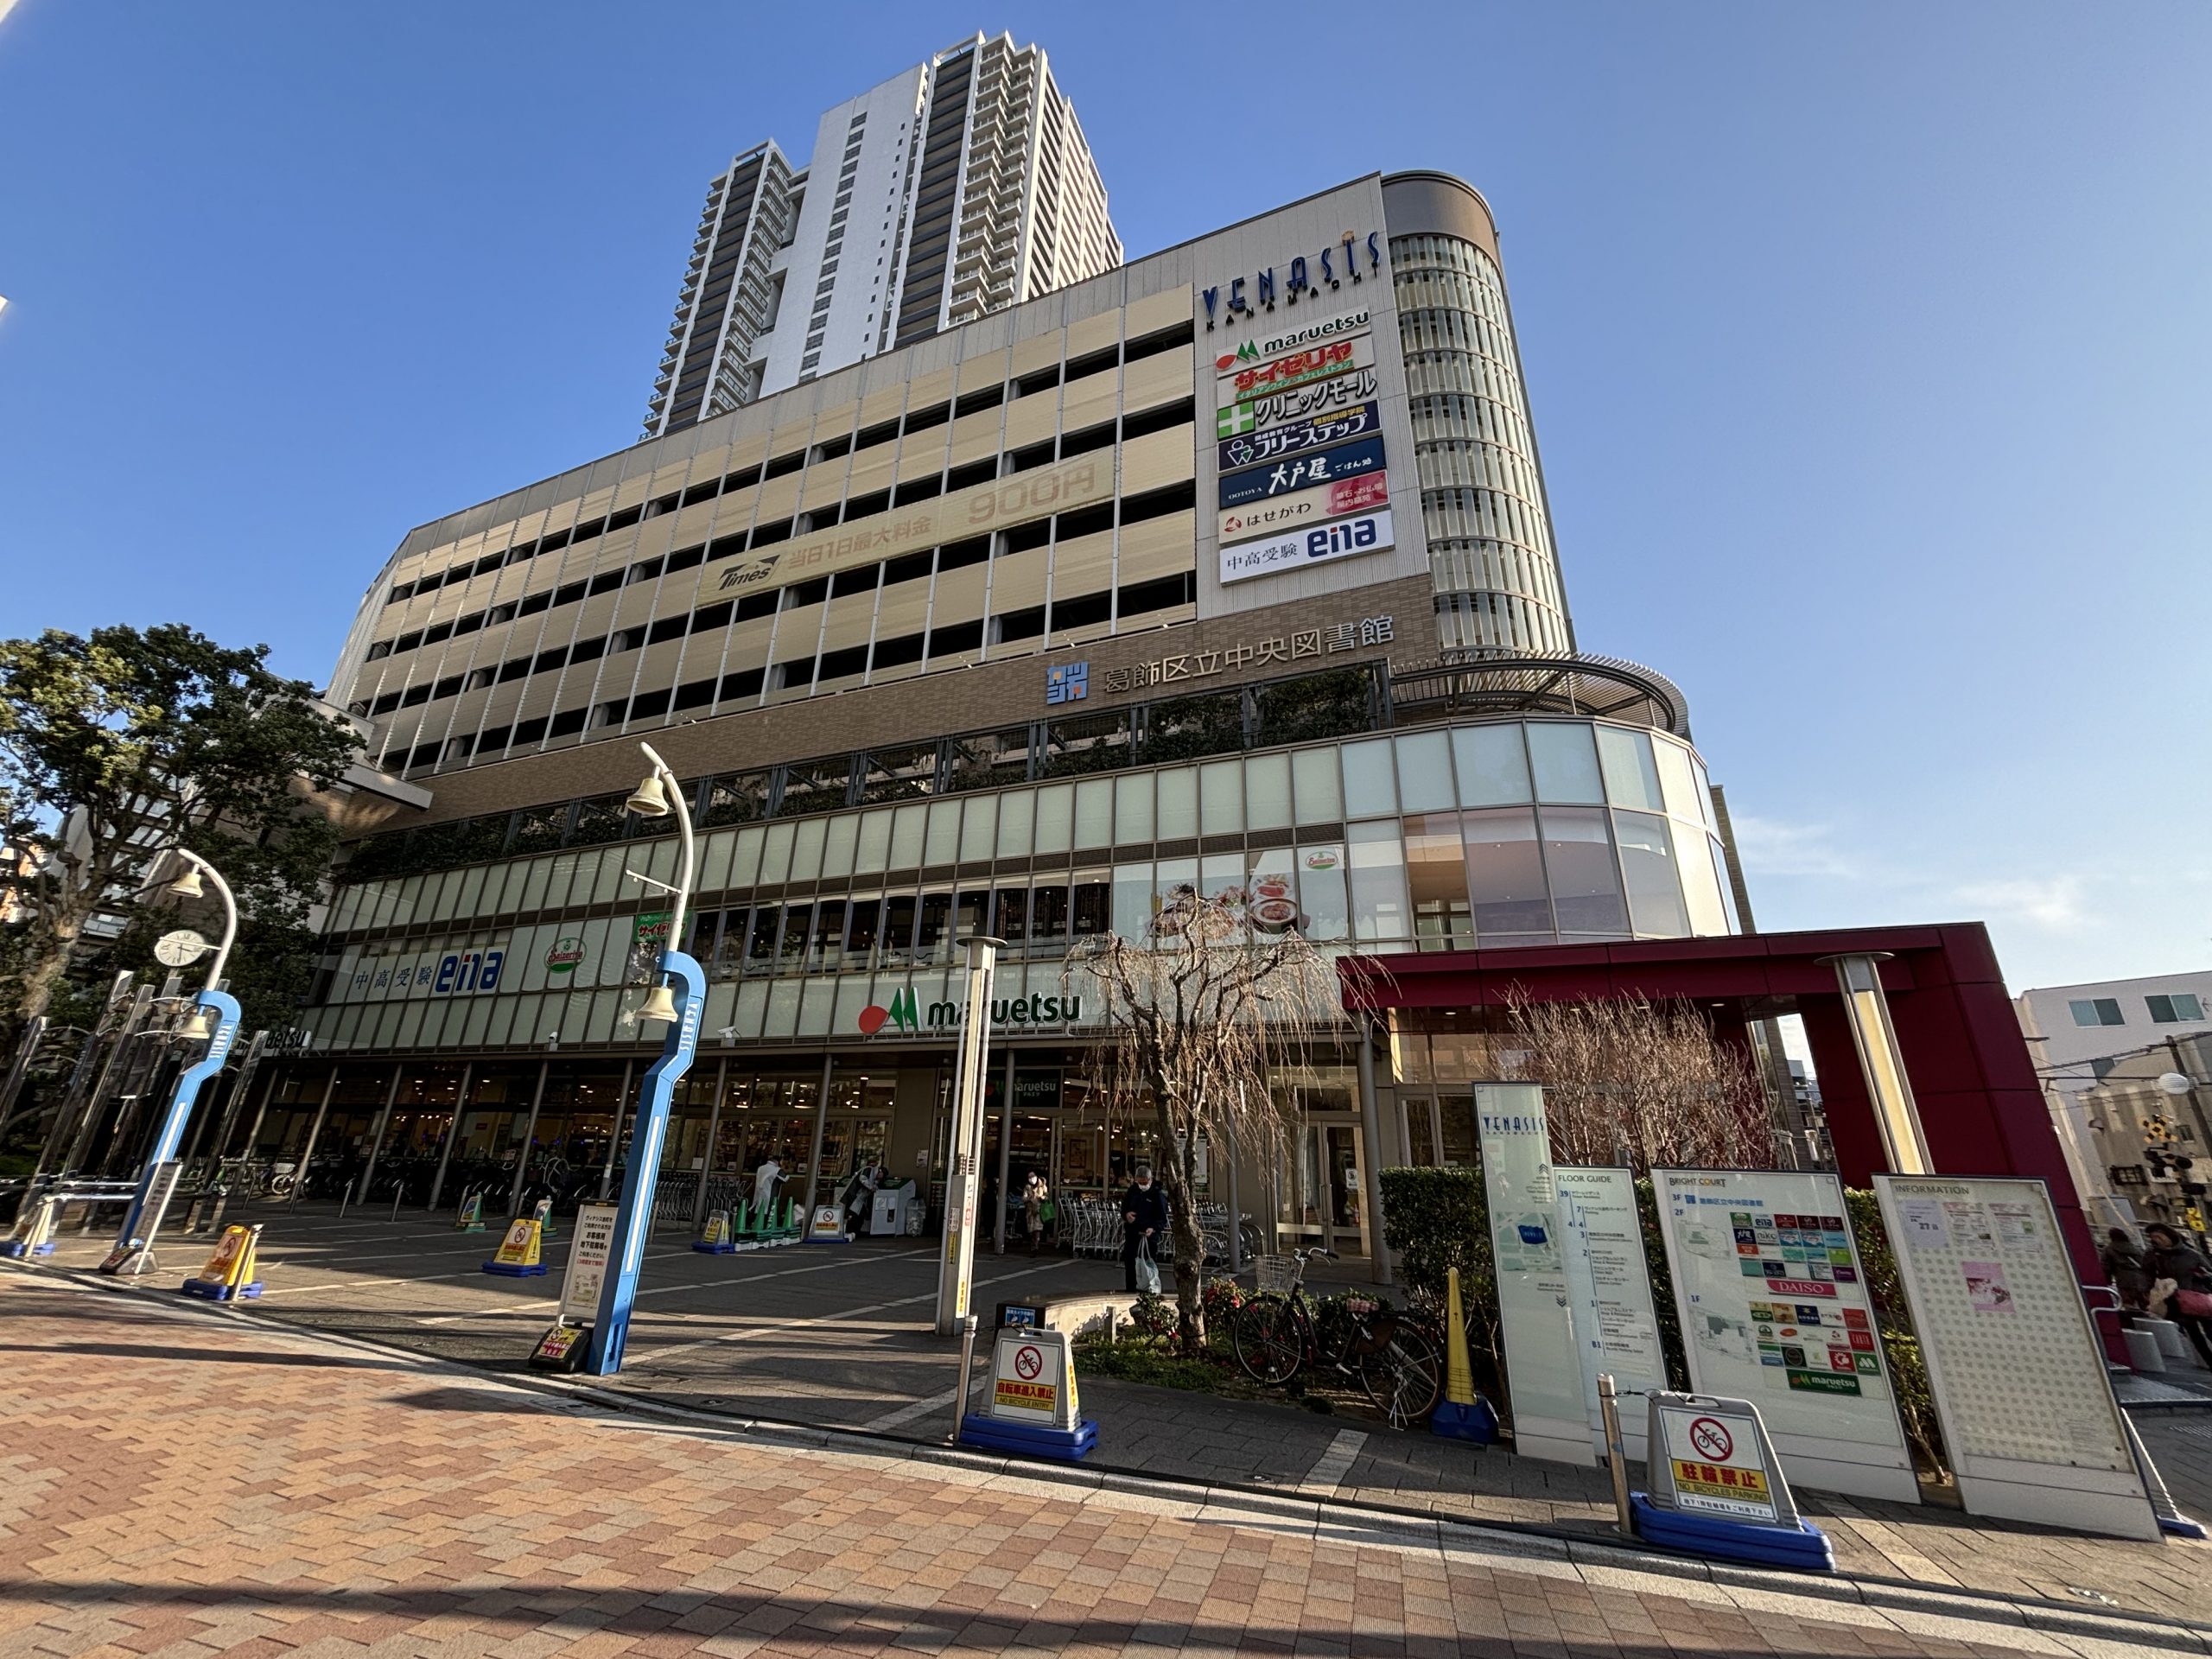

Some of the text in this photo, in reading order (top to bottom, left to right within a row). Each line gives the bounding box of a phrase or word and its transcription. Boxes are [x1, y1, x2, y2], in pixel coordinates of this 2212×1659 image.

[1202, 230, 1380, 324] VENASIS
[1263, 308, 1371, 355] maruetsu
[1235, 340, 1353, 390] サイゼリヤ
[1256, 370, 1377, 423] クリニックモール
[1255, 412, 1368, 459] フリーステップ
[1268, 456, 1332, 495] 大戸屋
[967, 462, 1096, 524] 900円
[1247, 503, 1312, 526] はせがわ
[1227, 543, 1298, 570] 中高受験
[719, 563, 772, 591] Times
[1104, 615, 1395, 692] 葛飾区立中央図書館
[356, 965, 432, 990] 中高受験
[928, 992, 1081, 1027] mauetsu
[1483, 1116, 1544, 1131] VENASIS
[1558, 1174, 1585, 1183] FLOOR
[1669, 1177, 1726, 1188] BRIGHT COURT
[1895, 1185, 1969, 1195] INFORMATION
[1779, 1281, 1824, 1294] DAISO
[997, 1382, 1054, 1400] 自転車進入禁止
[1811, 1376, 1856, 1388] maruetsu
[1008, 1398, 1031, 1408] BICYCLE
[1681, 1463, 1758, 1489] 駐輪禁止
[1677, 1482, 1768, 1502] NO BICYCLES PARKING
